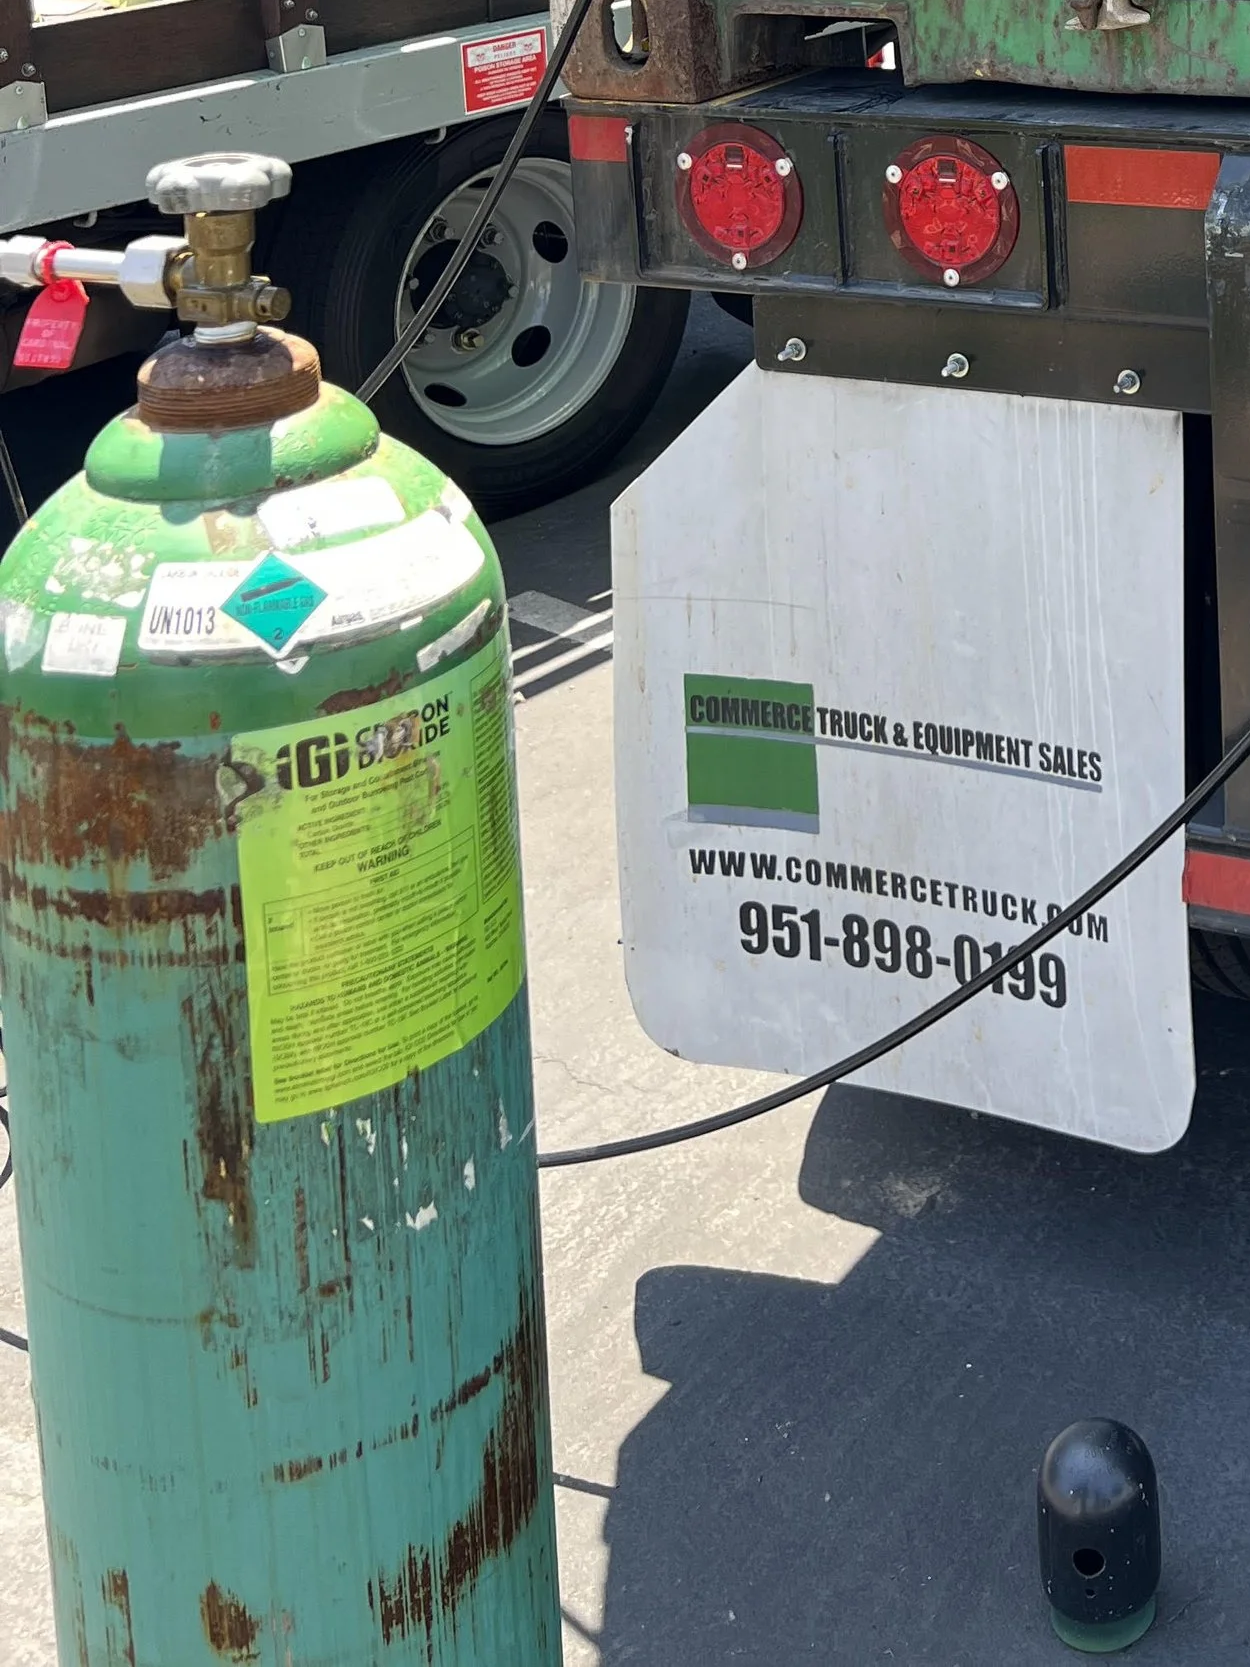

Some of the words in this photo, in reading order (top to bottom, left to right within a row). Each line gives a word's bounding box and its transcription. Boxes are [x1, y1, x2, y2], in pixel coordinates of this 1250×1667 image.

[149, 605, 216, 635] UN1013
[274, 628, 284, 640] 2
[690, 694, 813, 733] COMMERCE
[816, 707, 888, 745] TRUCK
[893, 722, 909, 747] &
[913, 721, 1033, 769] EQUIPMENT
[1038, 742, 1103, 782] SALES
[314, 860, 337, 874] KEEP
[339, 856, 356, 866] OUT
[357, 852, 369, 862] OF
[356, 845, 411, 873] WARNING
[738, 900, 1068, 1010] 951-898-0199
